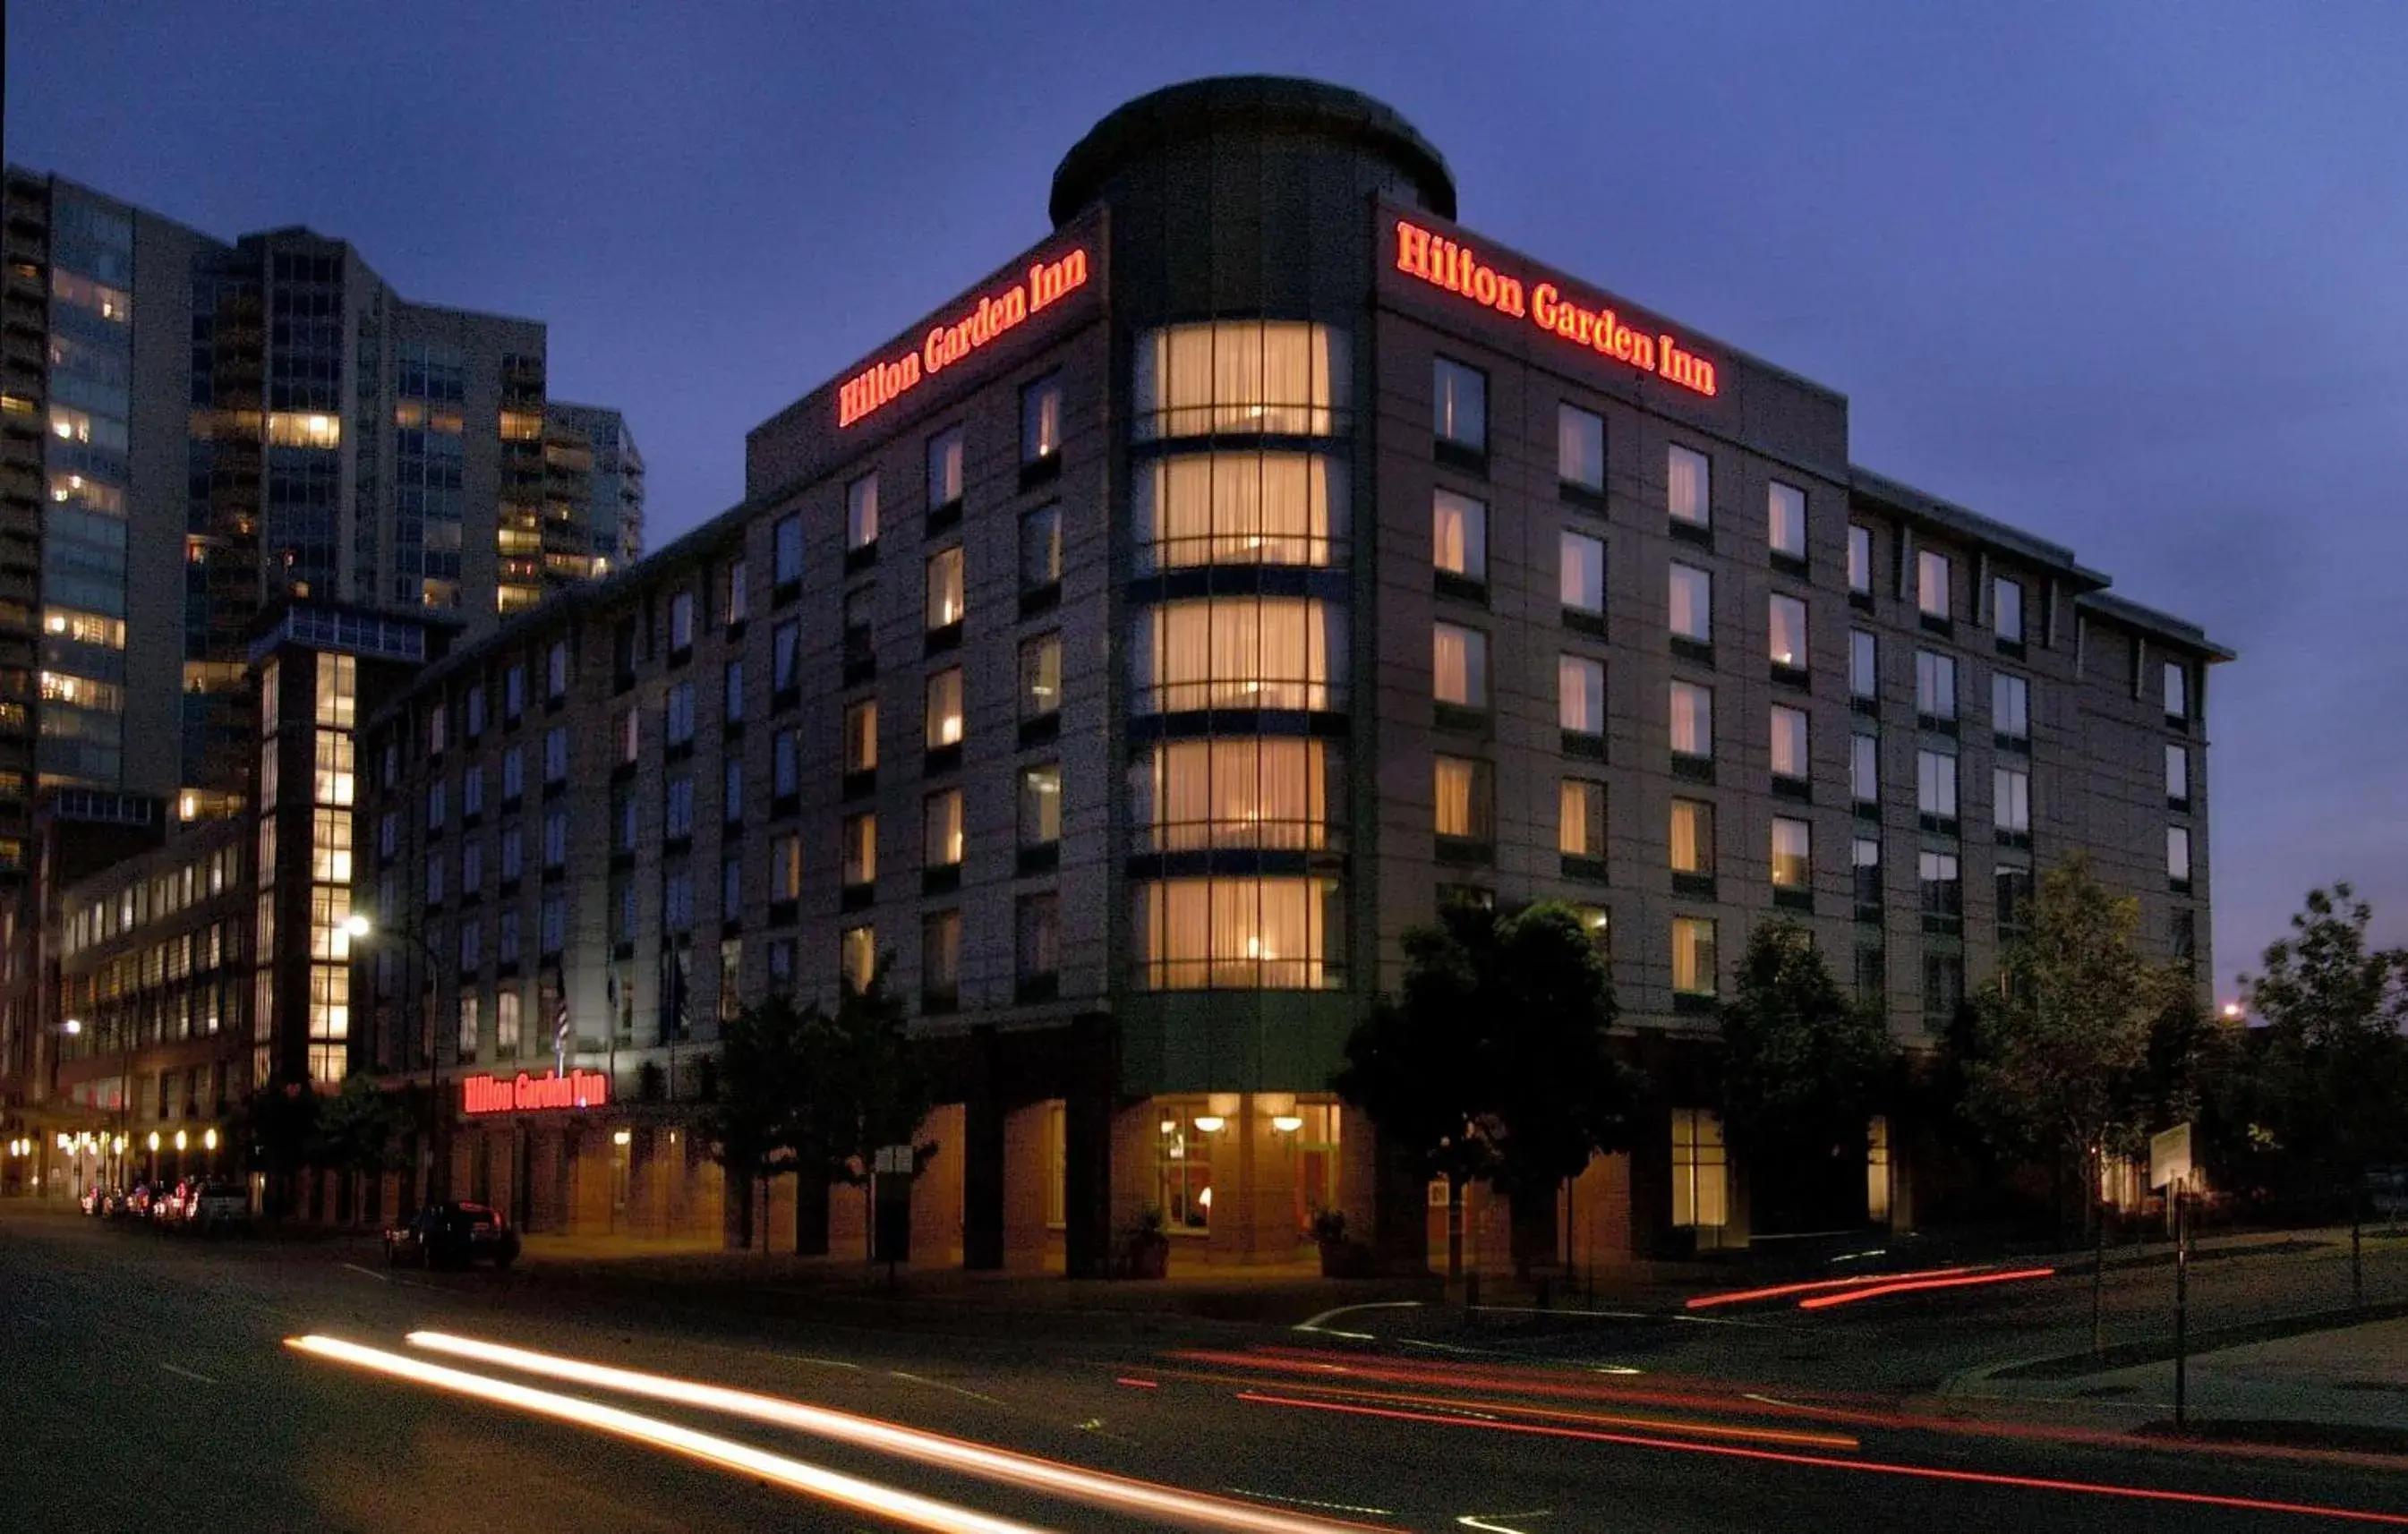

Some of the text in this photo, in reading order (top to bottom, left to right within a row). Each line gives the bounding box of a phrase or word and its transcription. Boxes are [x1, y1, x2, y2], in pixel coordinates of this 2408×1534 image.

[839, 249, 1087, 428] Hilton Garden Inn
[1396, 220, 1717, 396] Hilton Garden Inn
[465, 1075, 513, 1112] Hilton
[573, 1069, 605, 1106] Inn
